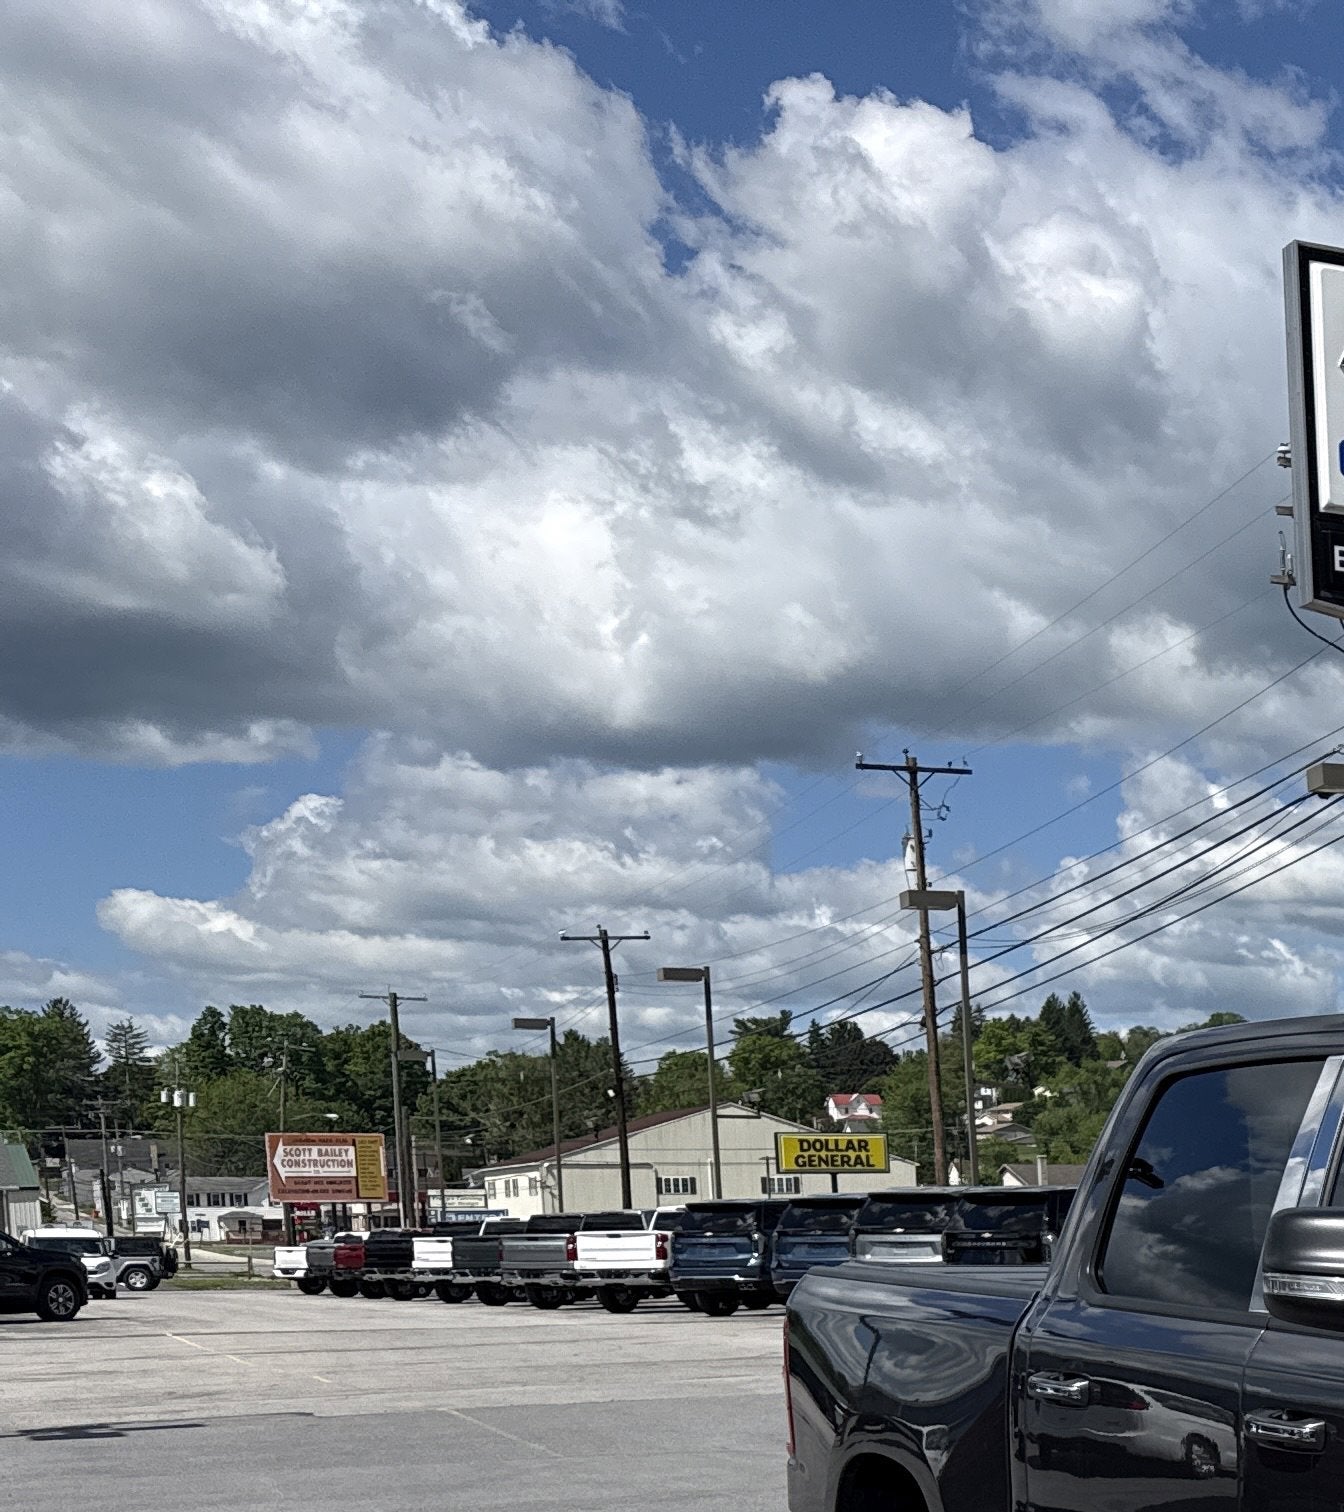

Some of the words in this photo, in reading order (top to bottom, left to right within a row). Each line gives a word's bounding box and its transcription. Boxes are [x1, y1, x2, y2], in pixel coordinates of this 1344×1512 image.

[798, 1139, 870, 1152] DOLLAR
[283, 1148, 312, 1157] SCOTT
[317, 1148, 350, 1157] BAILEY
[281, 1159, 353, 1168] CONSTRUCTION
[794, 1154, 875, 1167] GENERAL
